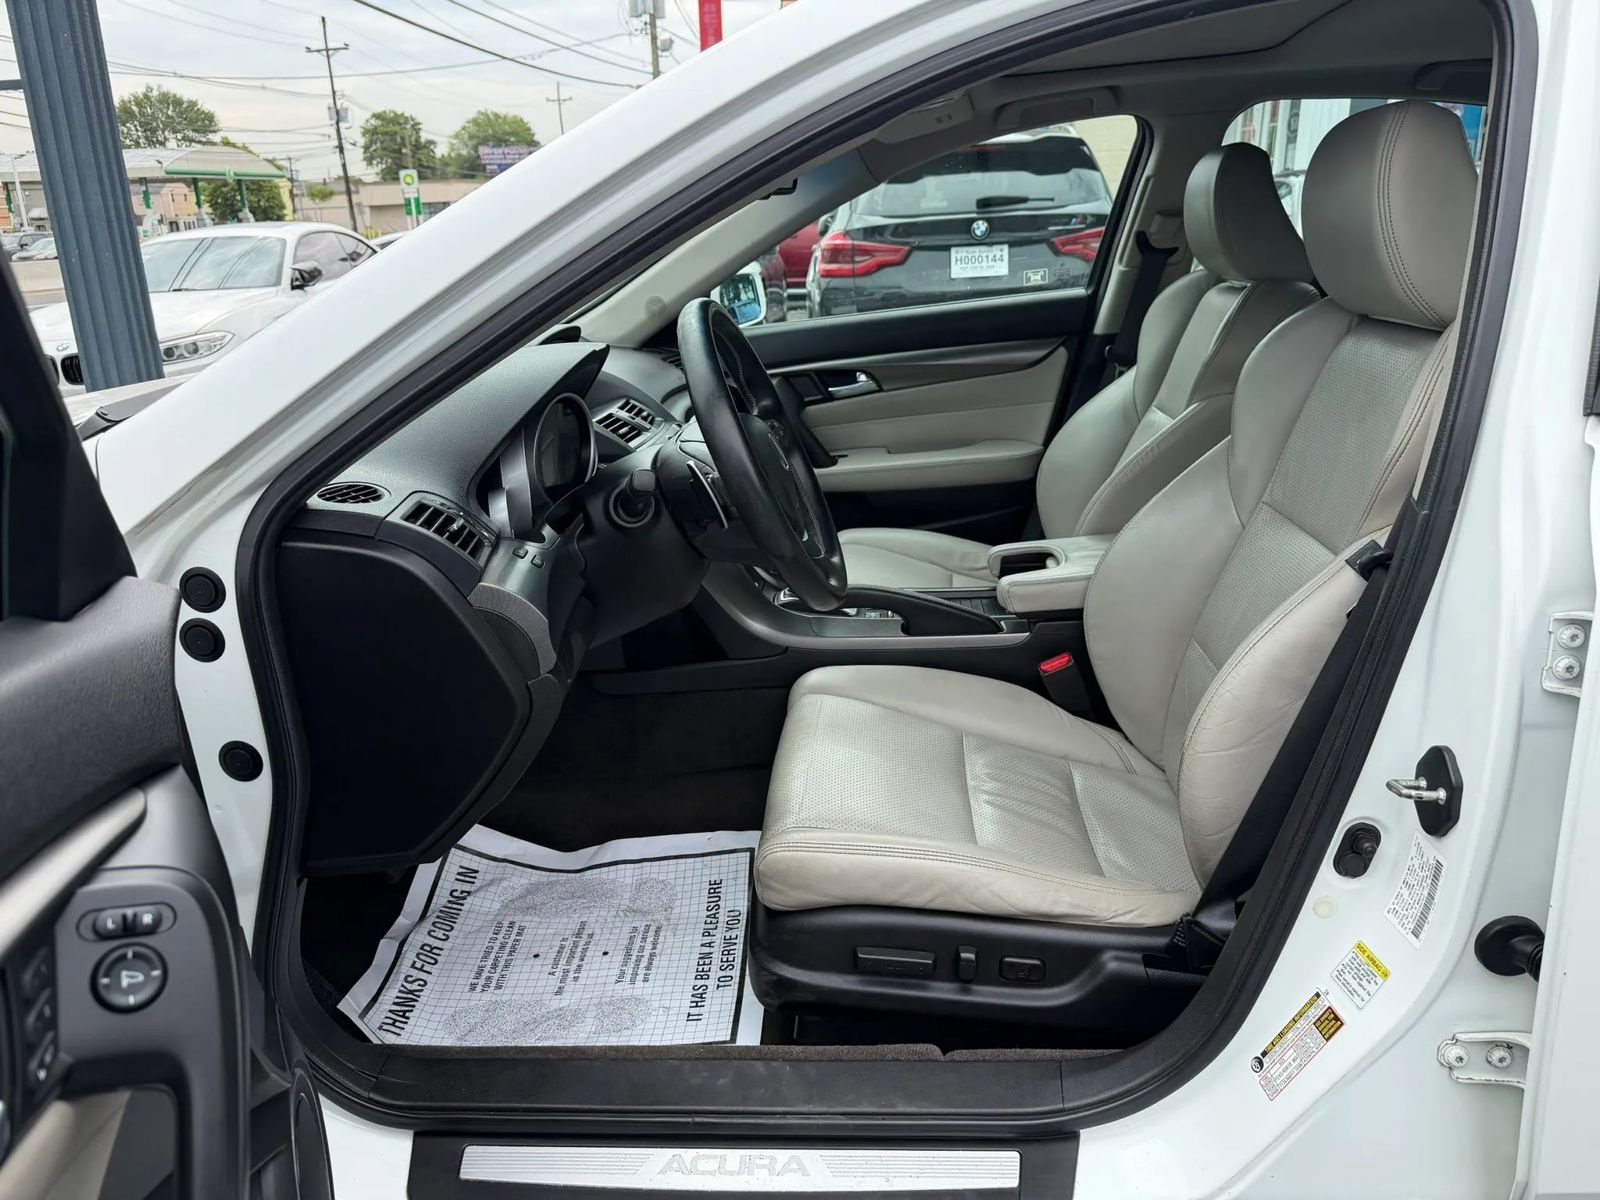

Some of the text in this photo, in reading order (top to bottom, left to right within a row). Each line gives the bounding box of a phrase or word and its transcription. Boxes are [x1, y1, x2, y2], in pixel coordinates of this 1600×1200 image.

[955, 254, 1004, 265] H000144
[142, 913, 153, 925] R
[702, 878, 723, 938] PLEASURE
[106, 917, 117, 929] L
[378, 865, 480, 1037] THANKS FOR COMING IN
[468, 920, 504, 992] WE HAVE TRIED TO KEEP
[480, 920, 517, 993] YOUR CARPETING CLEAN
[494, 924, 527, 991] WITH THIS PAPER MAT
[551, 943, 567, 970] customer
[716, 909, 742, 990] TO SERVE YOU
[1366, 954, 1382, 972] AIRBAG
[615, 968, 626, 985] Your
[694, 952, 714, 981] BEEN
[554, 984, 563, 996] the
[559, 968, 571, 985] most
[689, 984, 709, 1009] HAS
[1292, 994, 1317, 1022] INFORMATION
[686, 1012, 704, 1022] IT
[656, 1153, 812, 1177] ACURA
